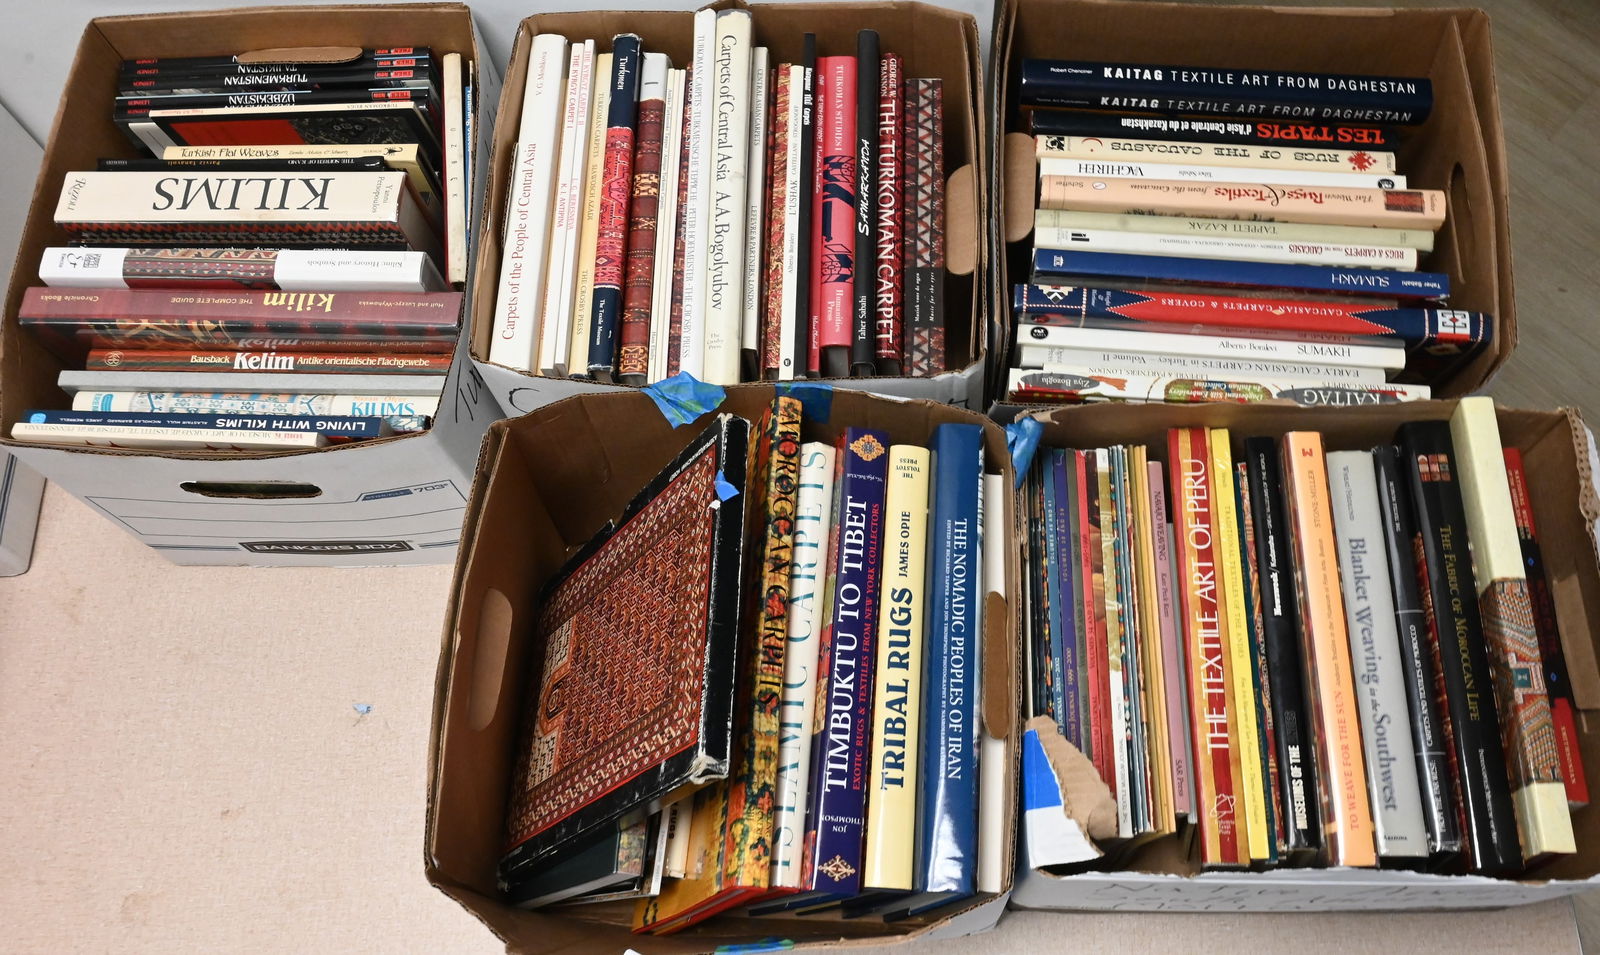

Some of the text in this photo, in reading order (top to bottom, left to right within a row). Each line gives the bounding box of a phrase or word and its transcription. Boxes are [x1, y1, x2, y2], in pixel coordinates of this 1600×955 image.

[224, 74, 308, 86] TURKMENISTAN
[616, 56, 630, 90] Turkmen
[1103, 66, 1416, 94] KAITAG TEXTILE ART FROM DAGHESTAN
[228, 94, 296, 104] UZBEKISTAN
[579, 92, 588, 116] CARPET
[716, 35, 737, 180] Carpets of Central Asia
[834, 65, 844, 146] TURKOMAN STUDIES
[1100, 96, 1412, 122] KAITAG TEXTILE ART FROM DAGHESTAN
[1121, 118, 1384, 144] LES TAPIS d'Asie Centrale Kazakhstan
[219, 148, 236, 157] Flat
[1110, 142, 1340, 163] RUGS OF THE CAUCASUS
[684, 35, 705, 302] TURKOMAN CARPETS TURKMENISCHE THE
[1078, 162, 1144, 177] VAGHIREH
[152, 176, 335, 212] KILIMS
[382, 184, 392, 206] Yanni
[858, 138, 870, 236] SAMARKANDA
[1172, 186, 1373, 205] Flat Rugs Textiles the
[557, 198, 566, 228] ANTIPINA
[876, 100, 896, 344] THE TURKOMAN CARPET
[502, 143, 537, 340] Carpets of People Central Asia
[1188, 222, 1278, 236] TAPPETI KAZAK
[1288, 245, 1404, 260] RUGS CARPETS CAUCASUS
[1332, 273, 1390, 287] SUMAKH
[1424, 281, 1442, 290] Taher
[262, 292, 336, 312] kilim
[827, 301, 836, 322] Press
[834, 290, 844, 332] Humanities
[1160, 298, 1343, 317] CAUCASIAN CARPETS COVERS
[576, 310, 584, 335] PRESS
[858, 295, 867, 341] Taher Sabahi
[191, 354, 230, 364] Bausback
[234, 352, 295, 370] Kelim
[376, 357, 430, 368] Flachgewebe
[1297, 345, 1352, 357] SUMAKH
[1112, 354, 1360, 378] EARLY CAUCASIAN CARPETS Turkey Volume
[1074, 378, 1090, 388] Ziya
[1168, 388, 1207, 399] Embroidery
[1304, 390, 1380, 406] KAITAG
[216, 418, 366, 431] LIVING WITH KILIMS
[1308, 470, 1321, 528] STONE-MILLER
[252, 542, 402, 552] BANKERS BOX
[788, 452, 826, 643] CARPETS
[841, 496, 866, 574] TIBET
[898, 512, 910, 577] JAMES OPIE
[1155, 522, 1165, 560] WEAVING
[837, 583, 861, 622] TO
[1184, 459, 1230, 754] THE TEXTILE ART OF PERU
[852, 504, 880, 790] EXOTIC RUGS TEXTILES FROM NEW YORK COLLECTORS
[948, 518, 968, 780] THE NOMADIC PEOPLES OF IRAN
[1444, 554, 1480, 721] FABRIC LIFE
[1348, 537, 1399, 812] Blanket the Southwest
[880, 588, 912, 790] TRIBAL RUGS
[824, 632, 858, 792] TIMBUKTU
[1056, 696, 1064, 726] JOURNAL
[1423, 716, 1433, 747] CARPETS
[1334, 690, 1359, 832] TO WEAVE FOR THE SUN
[1288, 744, 1308, 830] MUSEUMS THE
[822, 815, 860, 824] THOMPSON
[832, 824, 848, 832] JON
